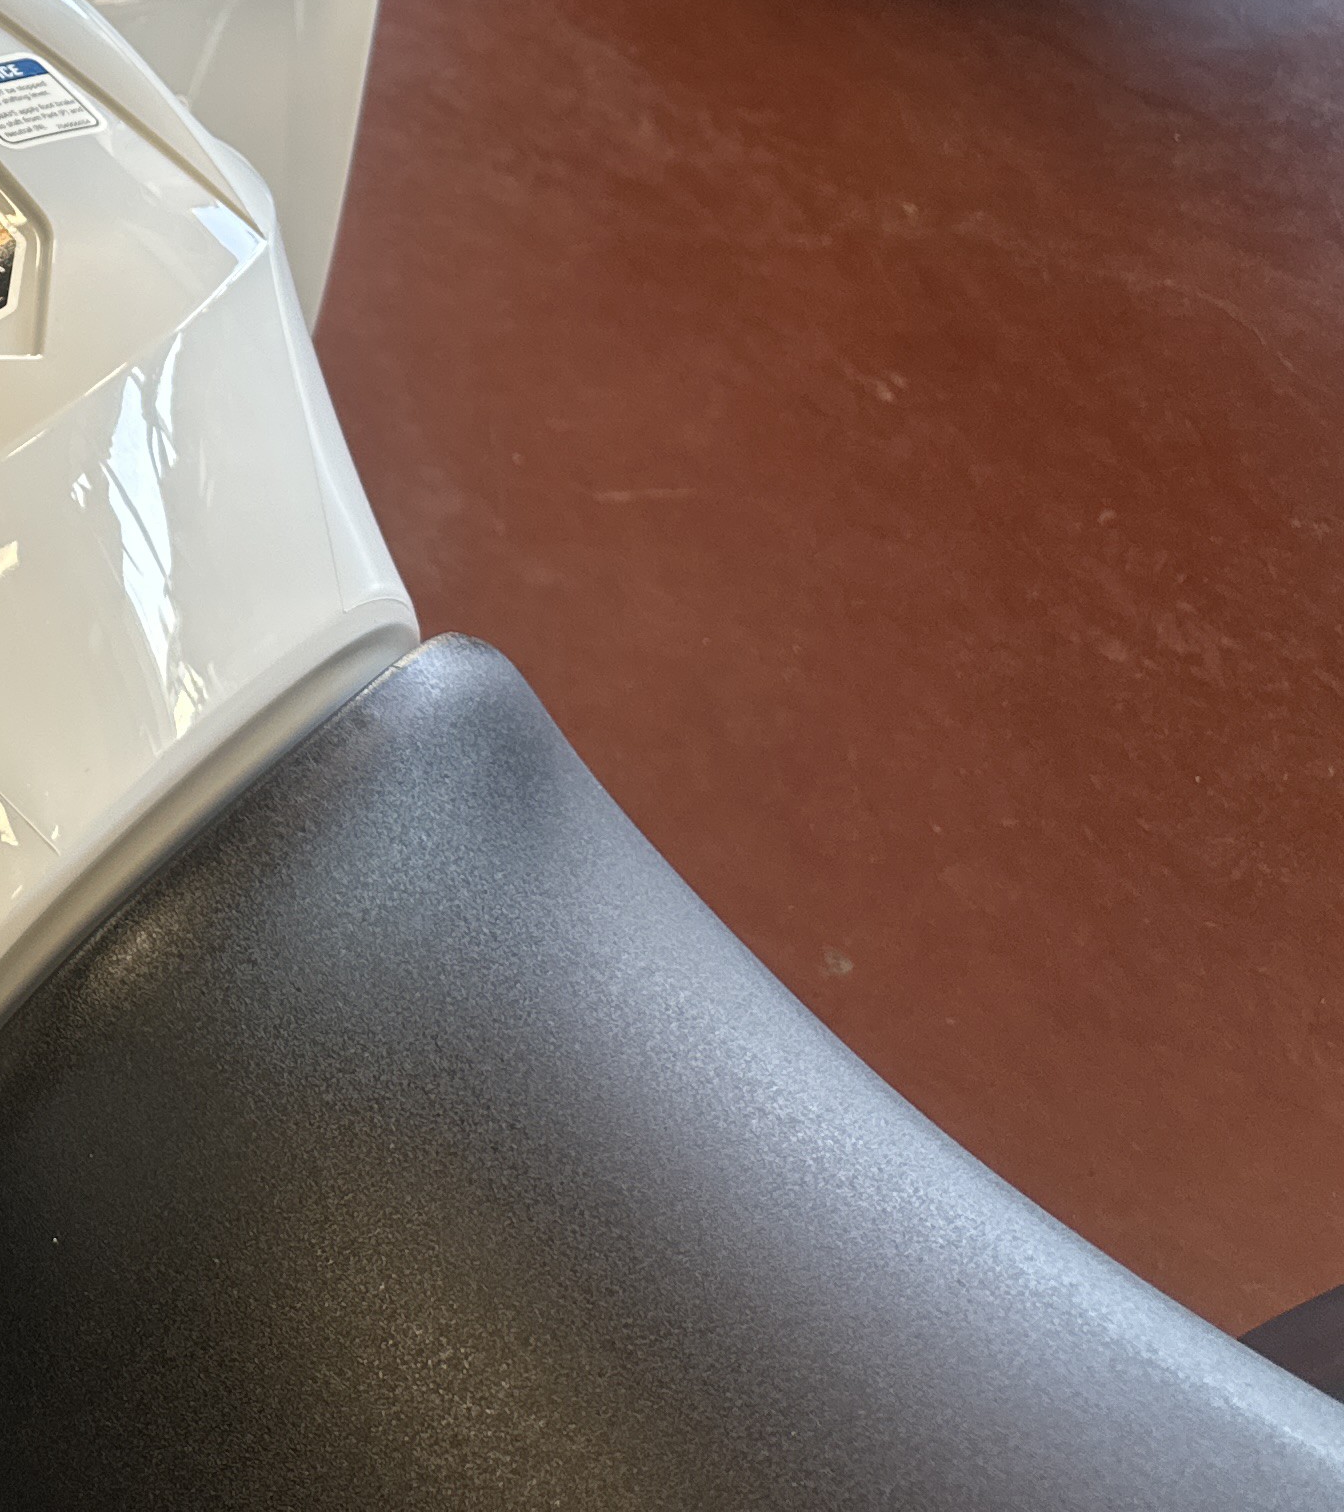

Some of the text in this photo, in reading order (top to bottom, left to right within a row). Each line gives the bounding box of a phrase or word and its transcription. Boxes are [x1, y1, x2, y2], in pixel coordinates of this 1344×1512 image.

[14, 80, 48, 91] stopped
[0, 93, 31, 104] shifting
[16, 105, 41, 114] apply
[36, 102, 56, 110] foot
[52, 97, 76, 107] brake
[3, 119, 24, 127] shift
[21, 114, 44, 123] from
[39, 111, 60, 119] Park
[2, 126, 34, 137] Neutral
